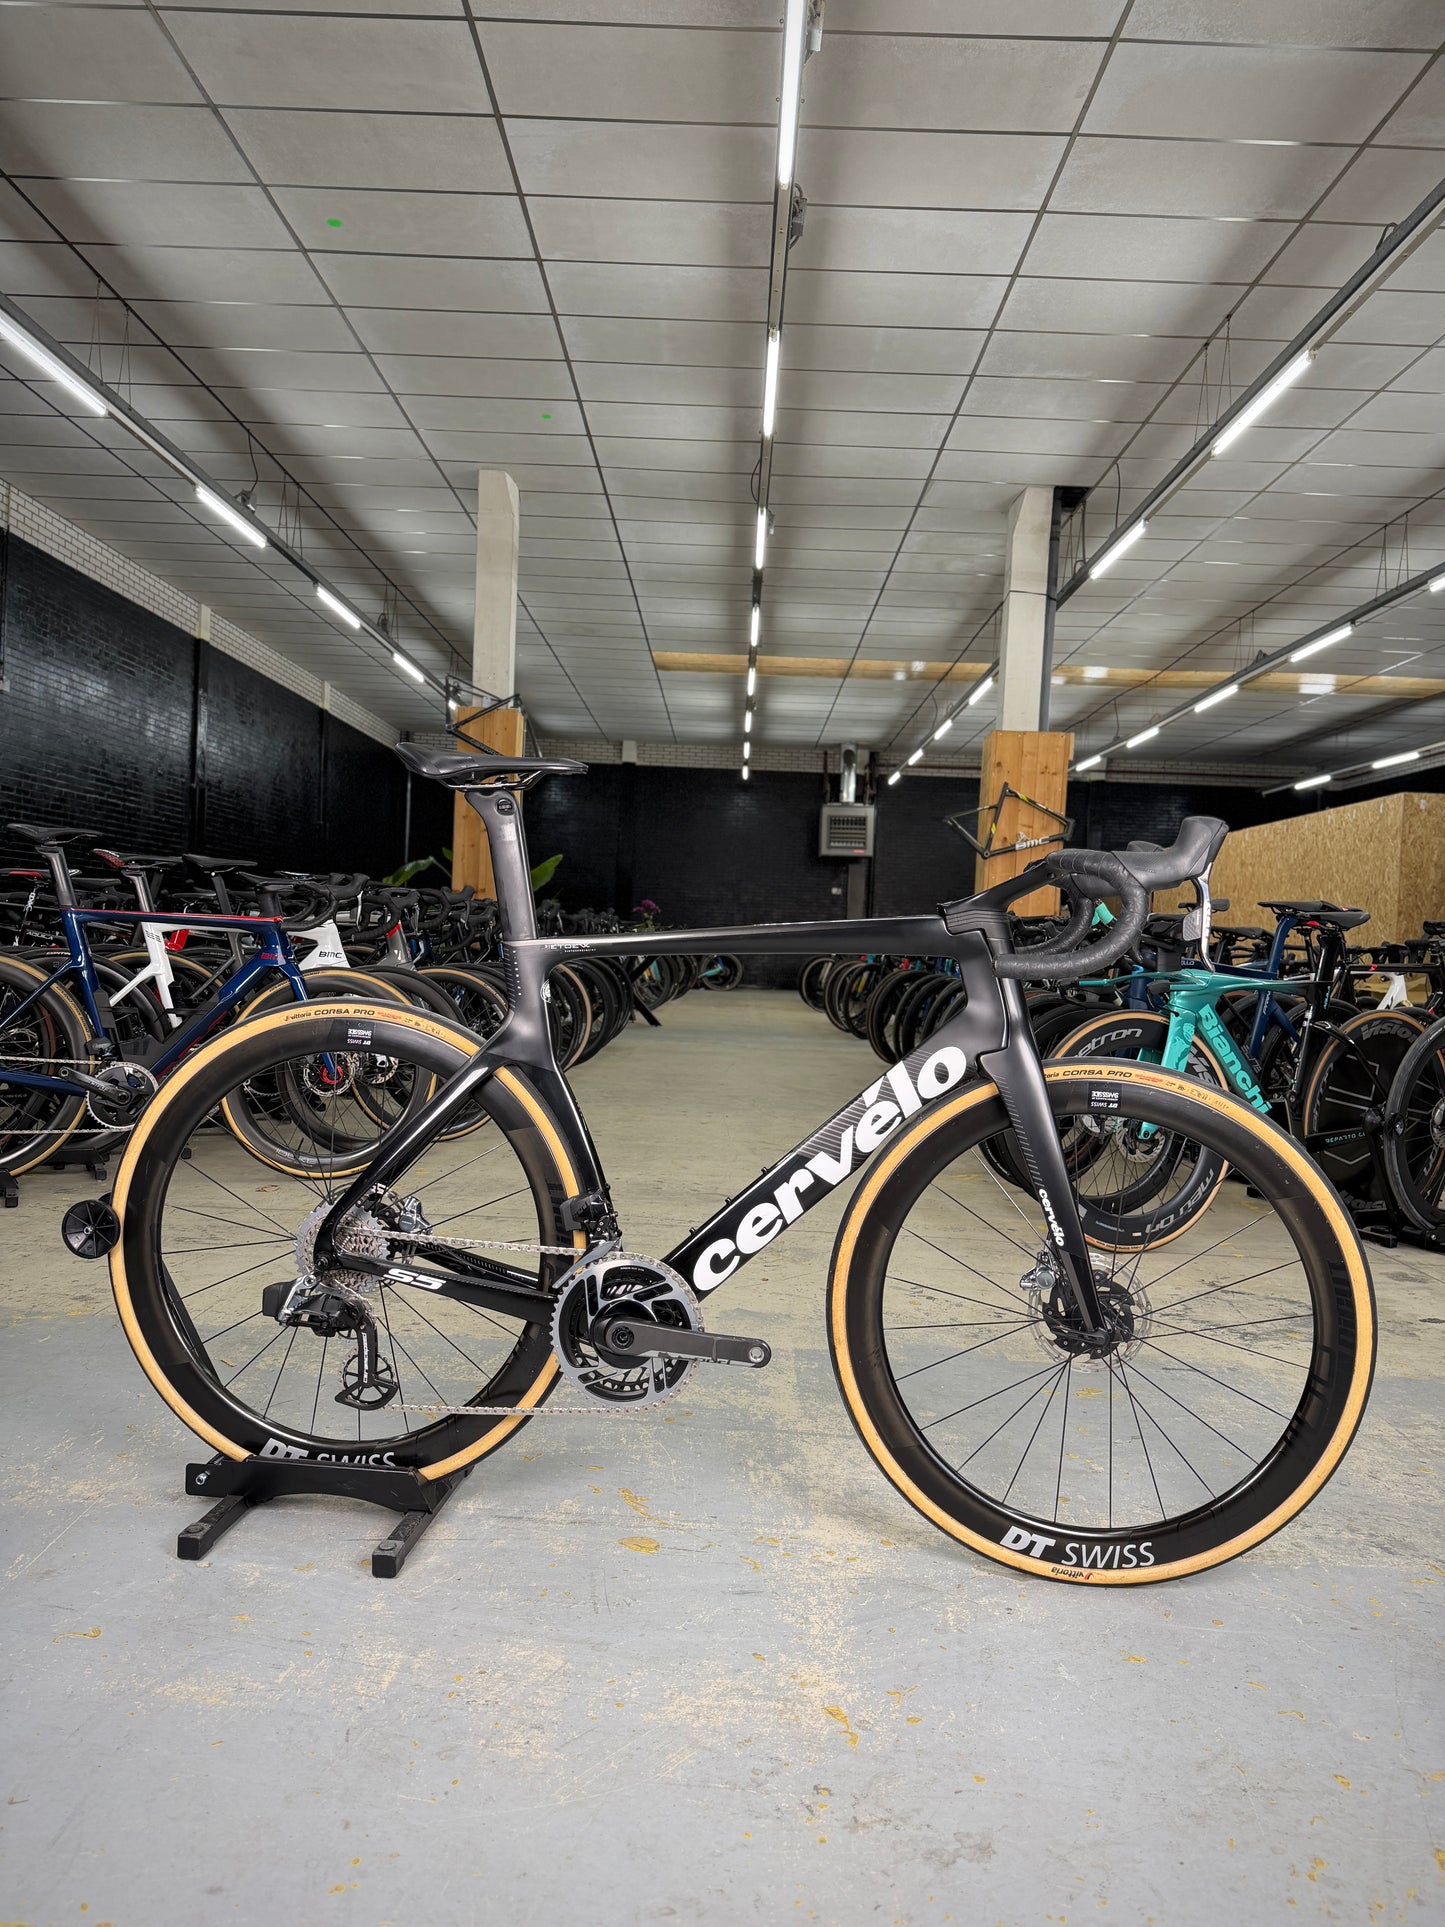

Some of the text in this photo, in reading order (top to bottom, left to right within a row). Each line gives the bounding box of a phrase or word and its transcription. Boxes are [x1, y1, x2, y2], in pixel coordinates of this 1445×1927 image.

[1015, 836, 1050, 851] BMC
[319, 951, 343, 959] BMC
[314, 1008, 350, 1016] CORSA
[1074, 1028, 1142, 1057] etron
[1199, 1004, 1272, 1114] Bianchi
[1062, 1069, 1103, 1077] CORSA
[1107, 1070, 1132, 1078] PRO
[692, 1046, 967, 1291] cervélo
[383, 1268, 447, 1290] S5
[1000, 1525, 1155, 1569] DT SWISS
[1051, 1567, 1084, 1580] vittoria
